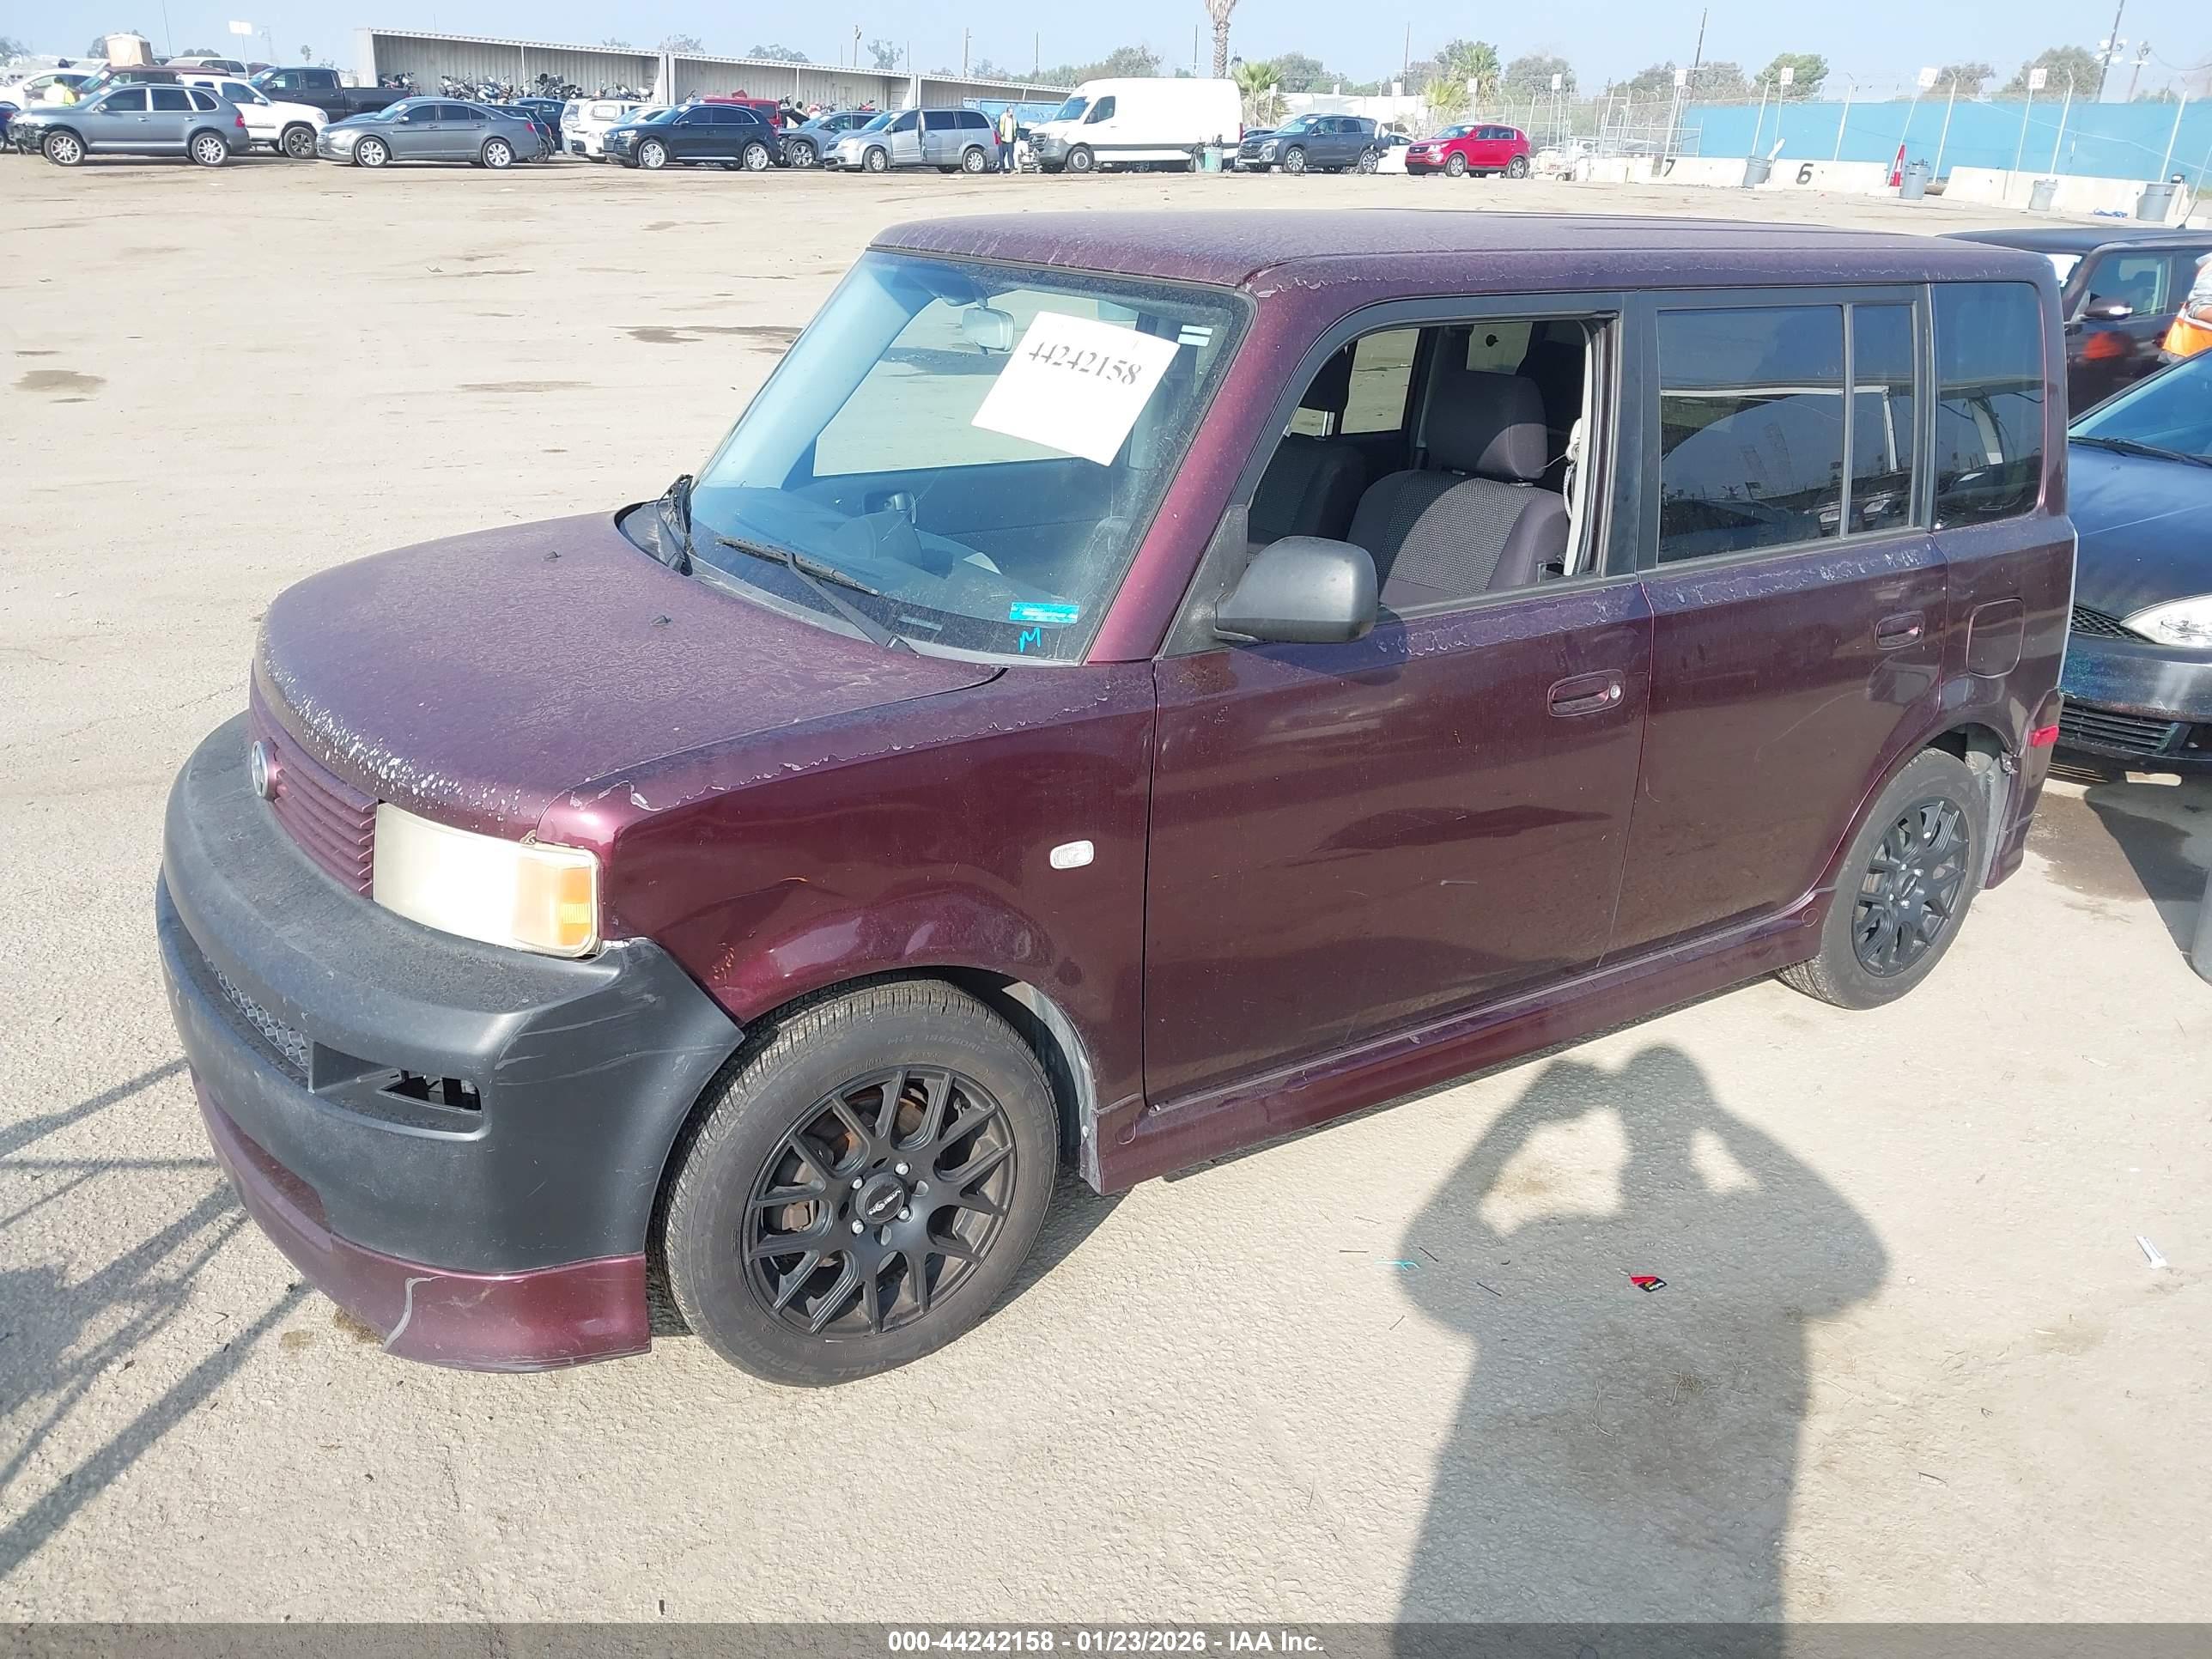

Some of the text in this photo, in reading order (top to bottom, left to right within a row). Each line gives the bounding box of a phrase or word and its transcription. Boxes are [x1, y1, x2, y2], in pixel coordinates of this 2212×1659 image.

[2032, 73, 2045, 85] 19
[1663, 158, 1676, 177] 7
[1796, 162, 1814, 185] 6
[1028, 341, 1142, 386] 44242158
[1018, 627, 1042, 653] M
